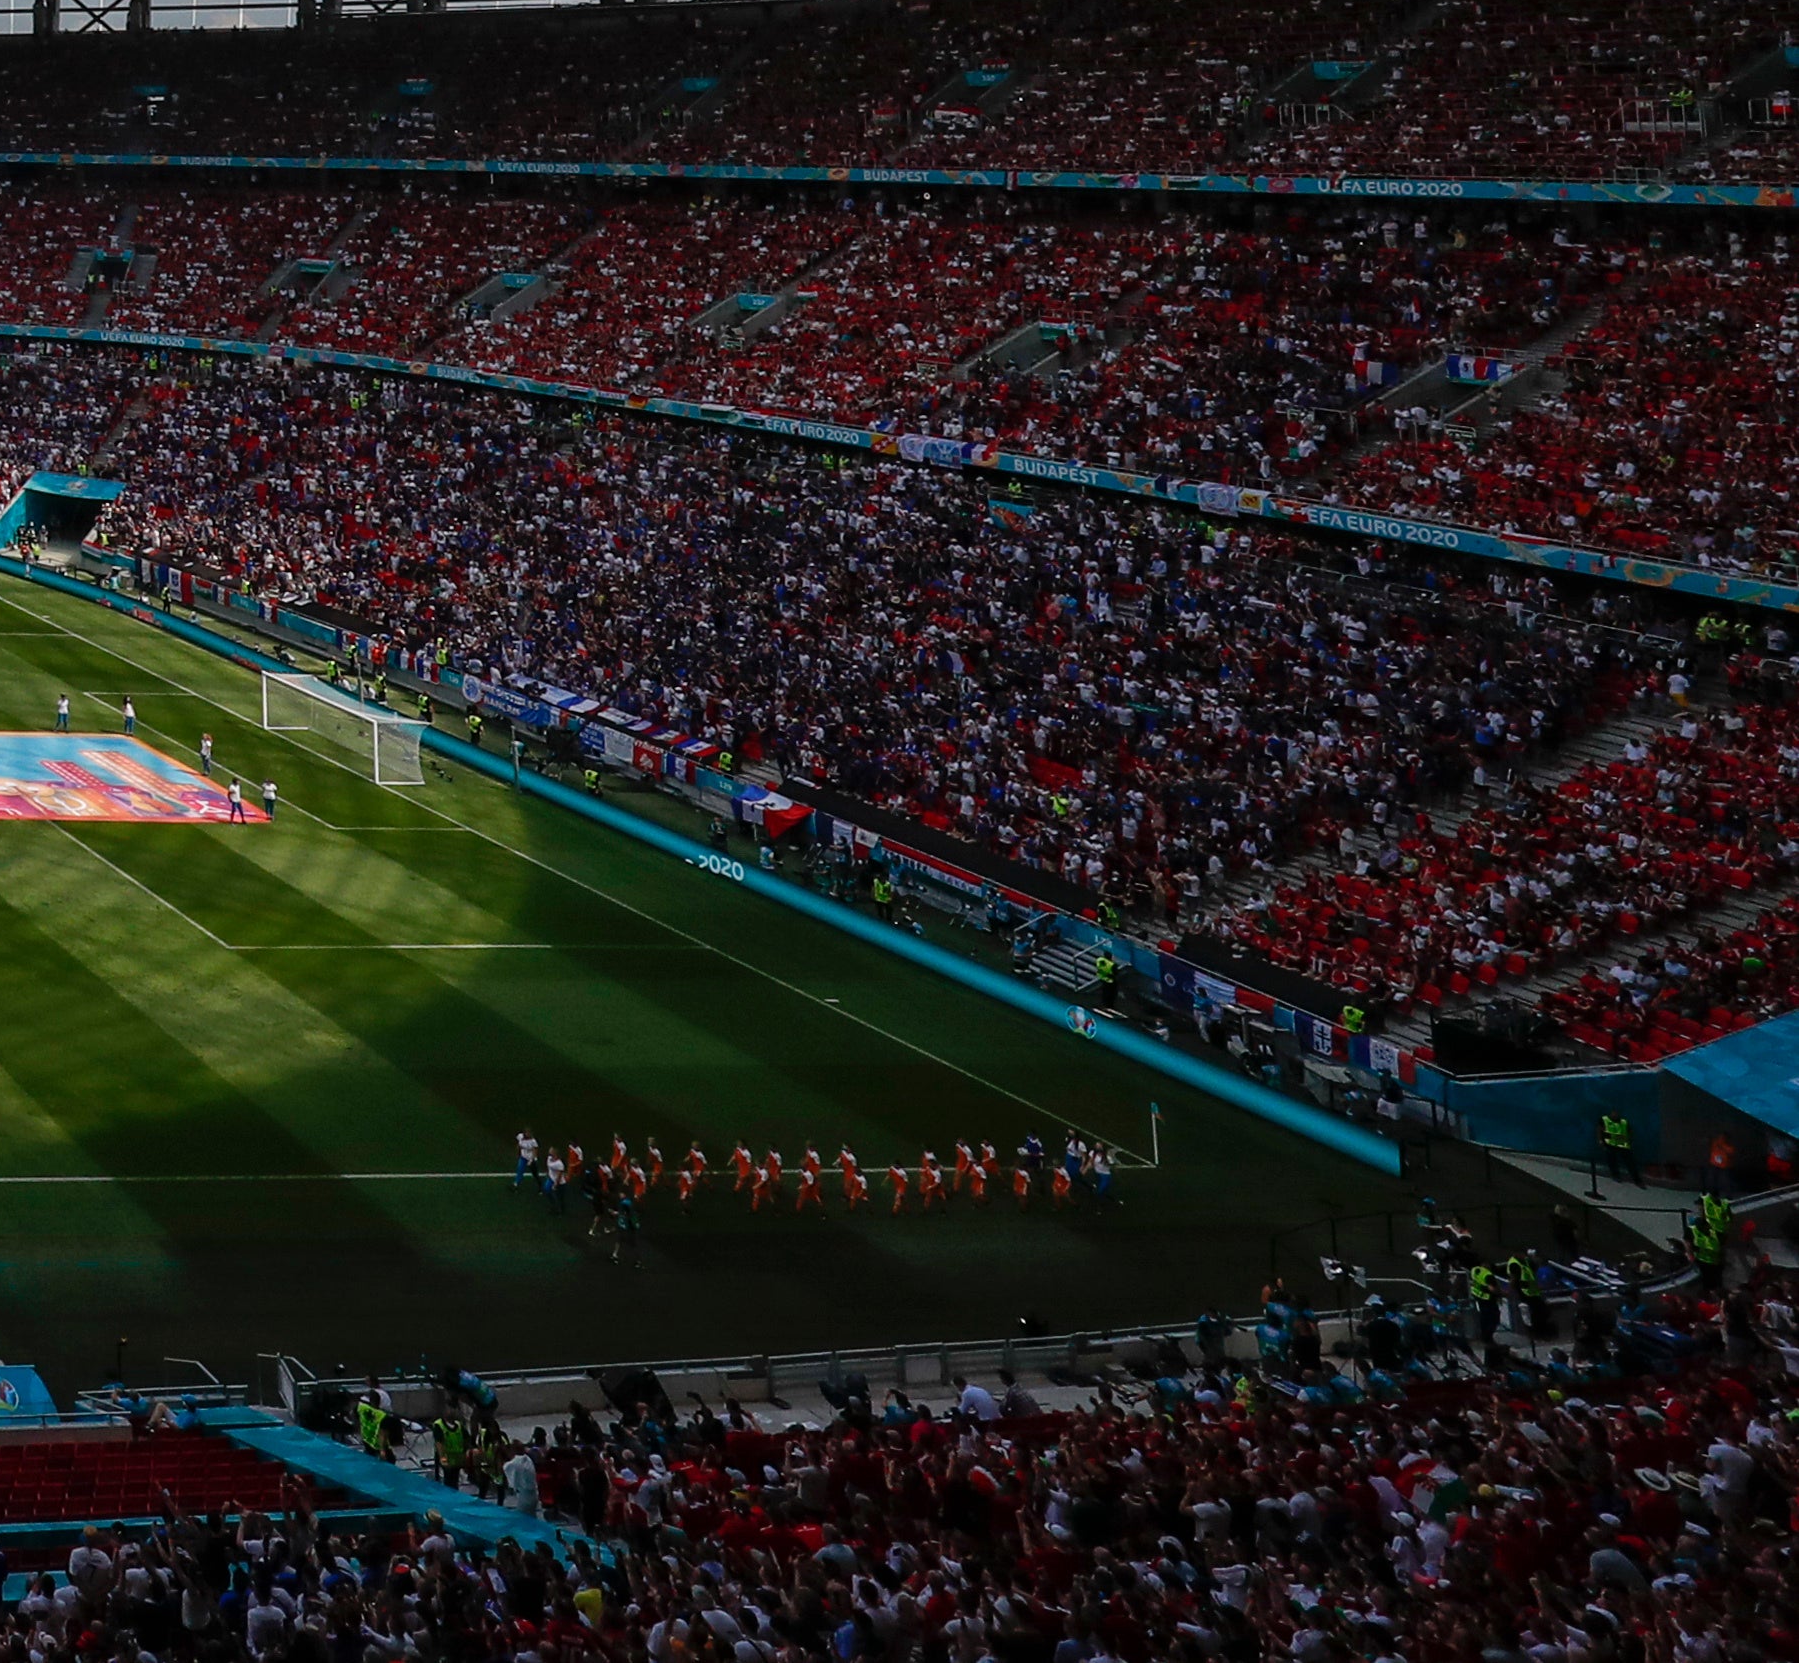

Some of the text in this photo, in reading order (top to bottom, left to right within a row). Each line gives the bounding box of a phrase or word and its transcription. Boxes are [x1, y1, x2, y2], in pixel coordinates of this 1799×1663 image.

[180, 156, 232, 166] BUDAPEST
[498, 162, 580, 174] UEFA EURO 2020
[863, 169, 930, 182] BUDAPEST
[1366, 181, 1413, 195] EURO
[1417, 182, 1463, 196] 2020
[100, 332, 185, 348] UEFA EURO 2020
[437, 367, 486, 384] BUDAPES
[826, 429, 860, 444] 2020
[1013, 459, 1100, 485] BUDAPEST
[1306, 507, 1459, 548] EFA EURO 2020
[698, 854, 745, 881] 2020
